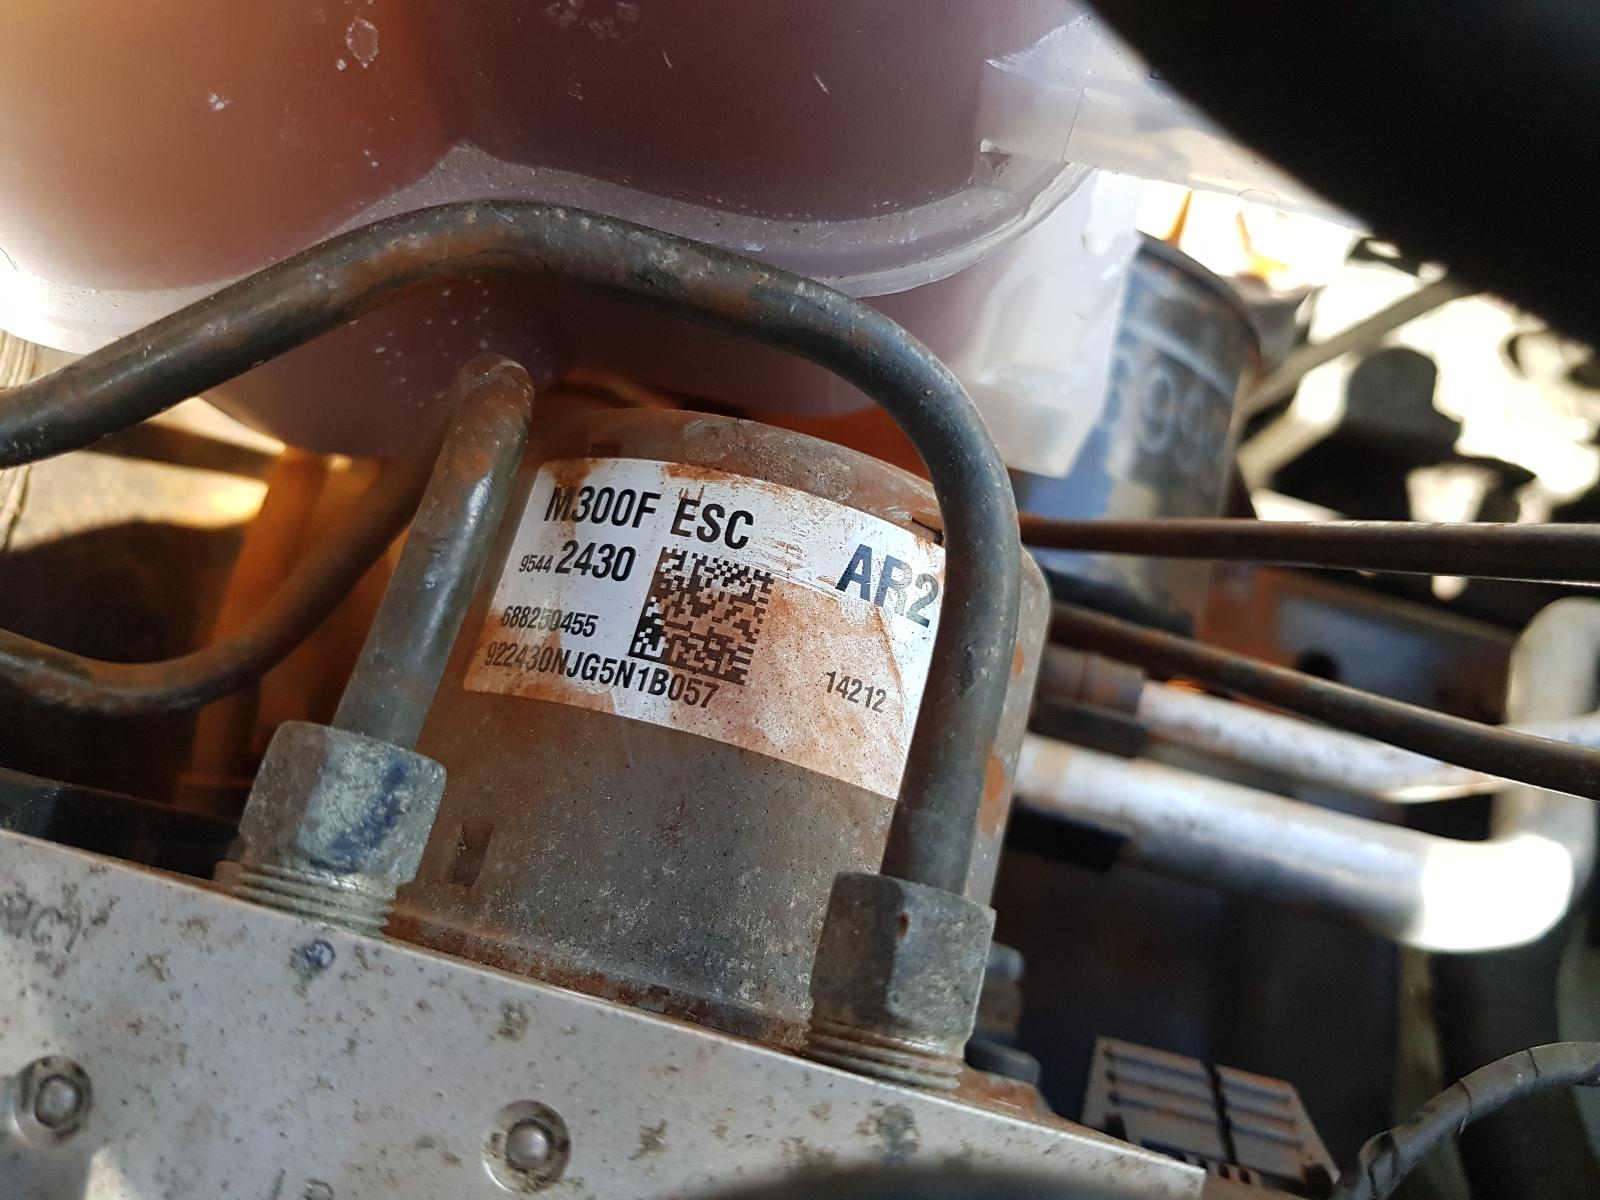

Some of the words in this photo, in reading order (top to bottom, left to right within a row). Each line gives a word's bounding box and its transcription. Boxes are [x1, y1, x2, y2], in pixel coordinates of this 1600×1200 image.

[544, 486, 660, 529] M300F
[670, 497, 755, 550] ESC
[518, 553, 552, 574] 9544
[555, 540, 637, 582] 2430
[835, 543, 940, 629] AR2
[500, 605, 599, 638] 688250455
[484, 643, 719, 710] 922430NJG5N1B057
[825, 670, 888, 714] 14212
